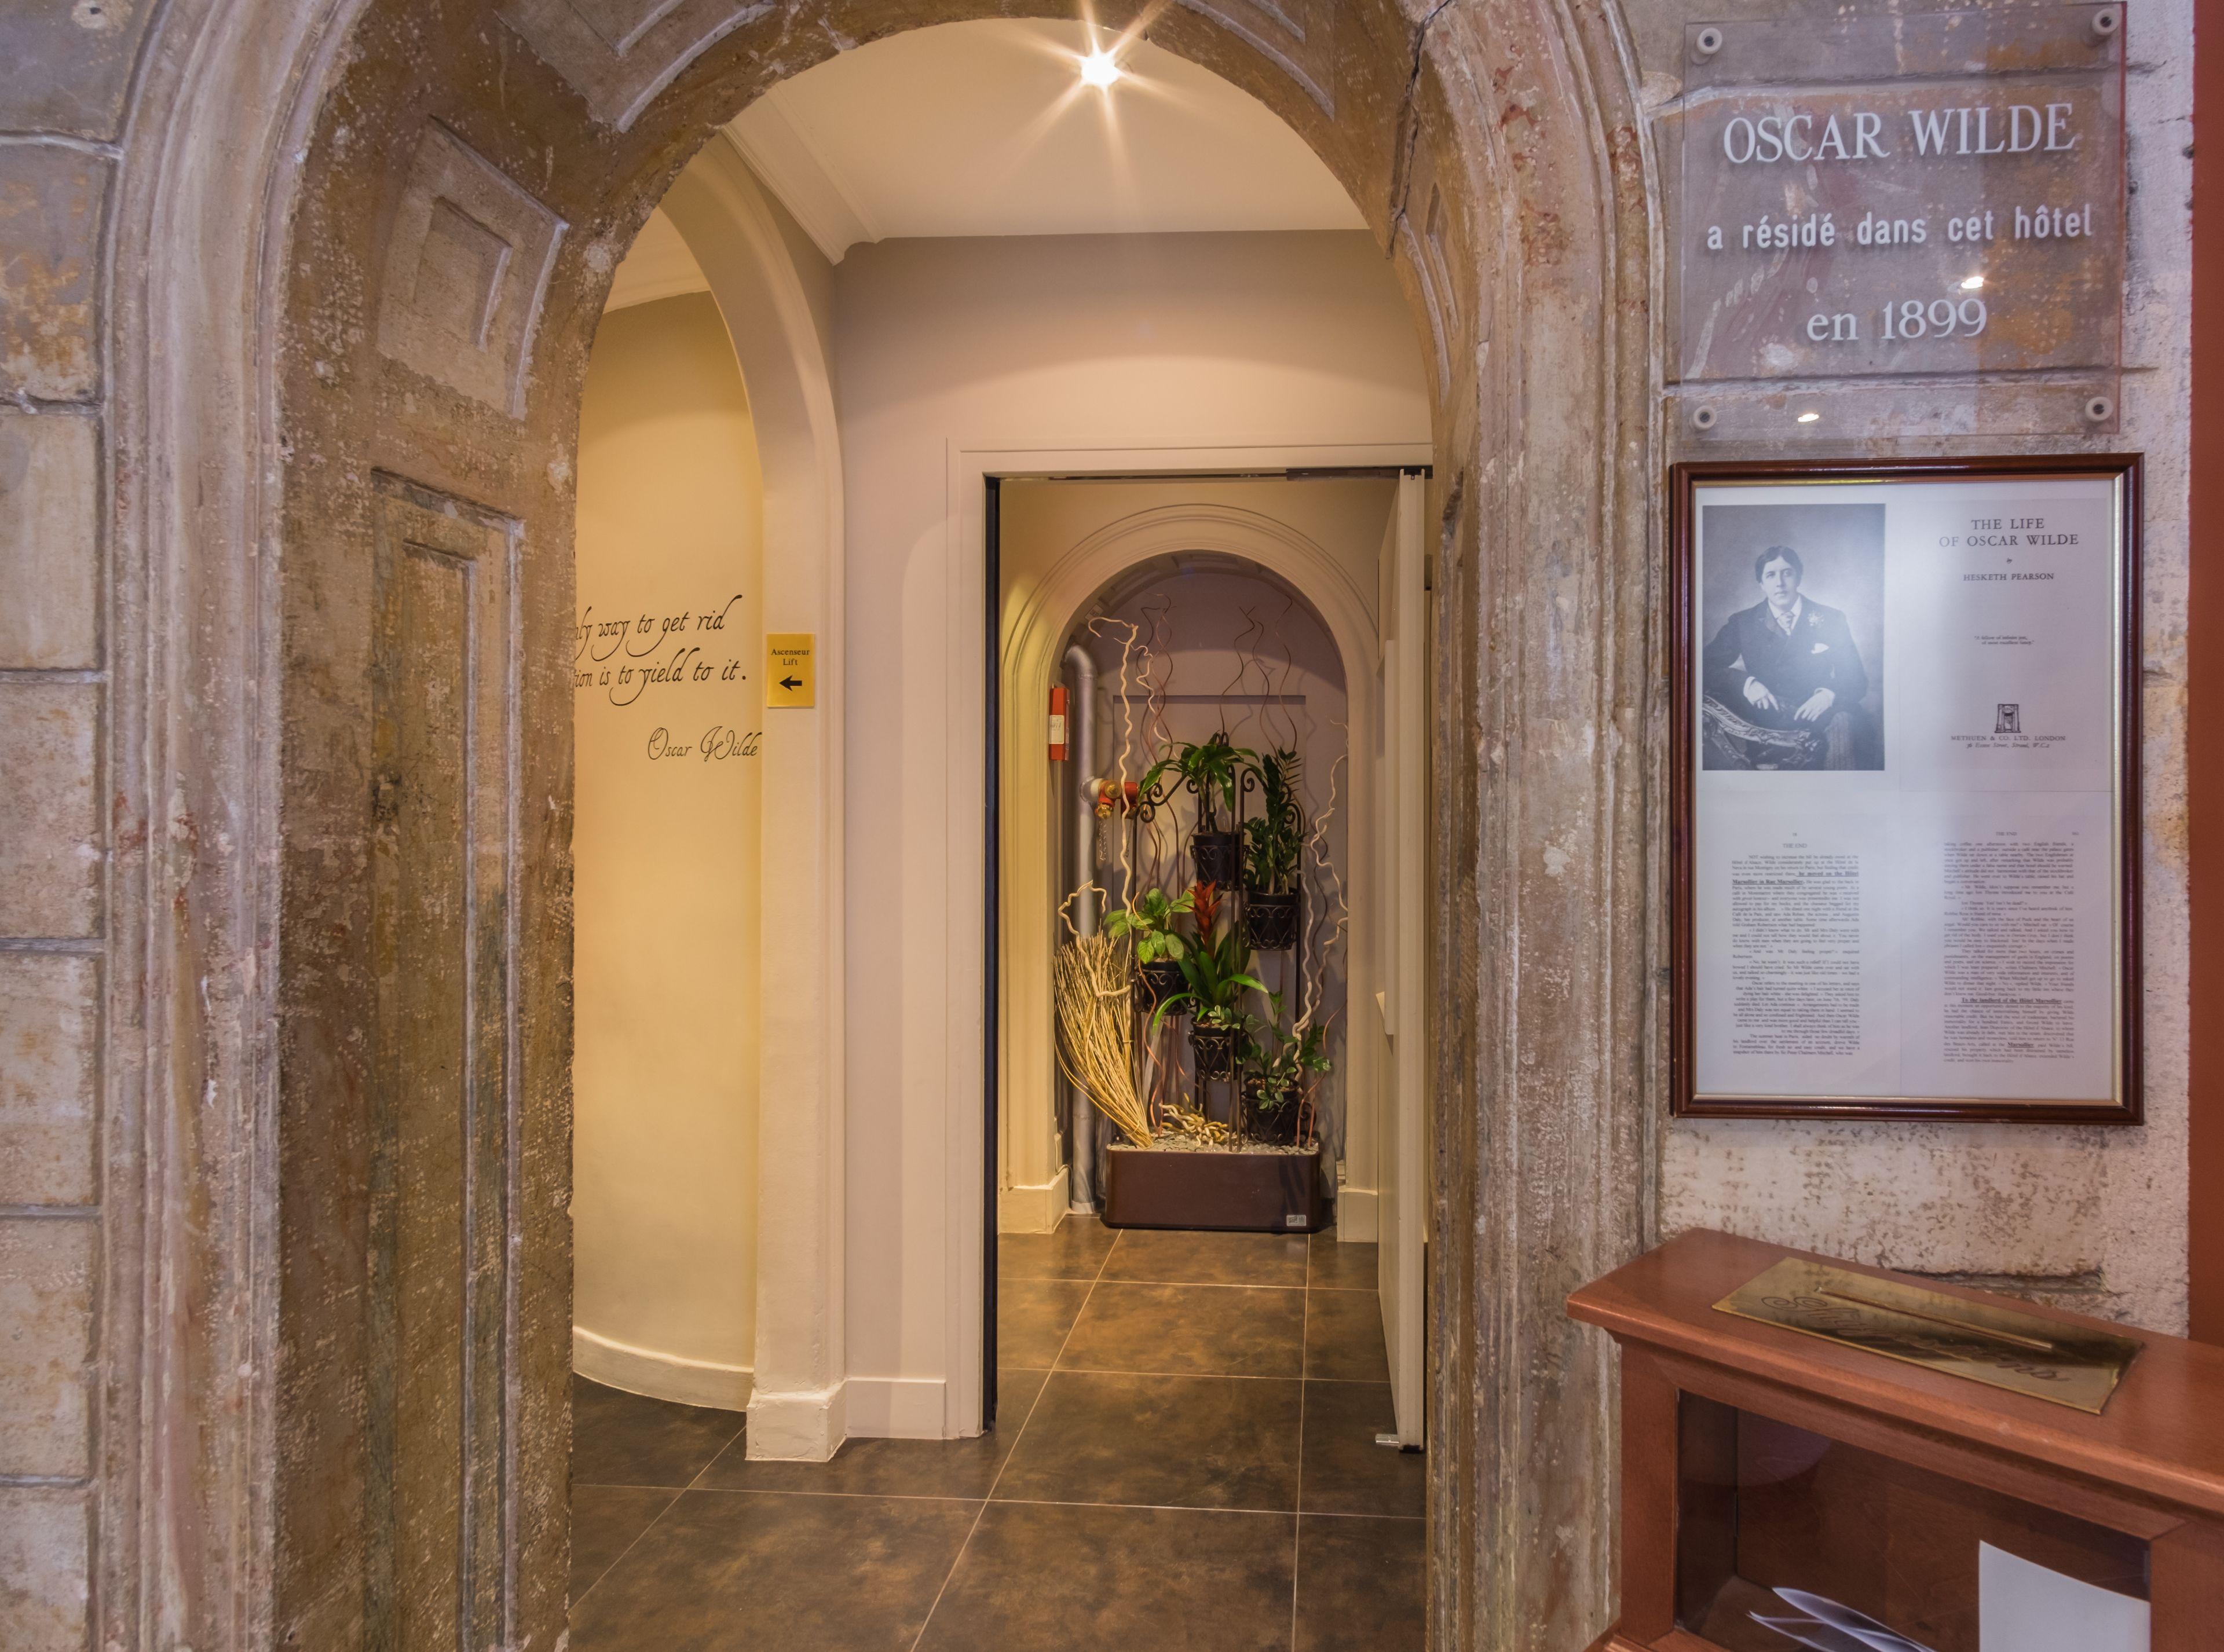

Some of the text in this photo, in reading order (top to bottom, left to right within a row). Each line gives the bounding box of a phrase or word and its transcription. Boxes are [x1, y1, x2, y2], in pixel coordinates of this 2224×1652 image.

[1724, 103, 2076, 164] OSCAR WILDE
[1707, 204, 2093, 250] a résidé dans cet hôtel
[1806, 298, 1988, 342] en 1899
[1971, 518, 2044, 530] THE LIFE
[1938, 534, 2079, 547] OF OSCAR WILDE
[637, 614, 656, 634] to
[697, 594, 743, 631] rid
[591, 620, 631, 662] way
[626, 611, 691, 658] get
[771, 648, 810, 656] Ascenseur
[599, 666, 611, 686] is
[609, 647, 700, 707] yield
[618, 665, 635, 685] to
[693, 660, 714, 682] to
[722, 658, 747, 682] it.
[647, 726, 763, 762] Oscar Wilde
